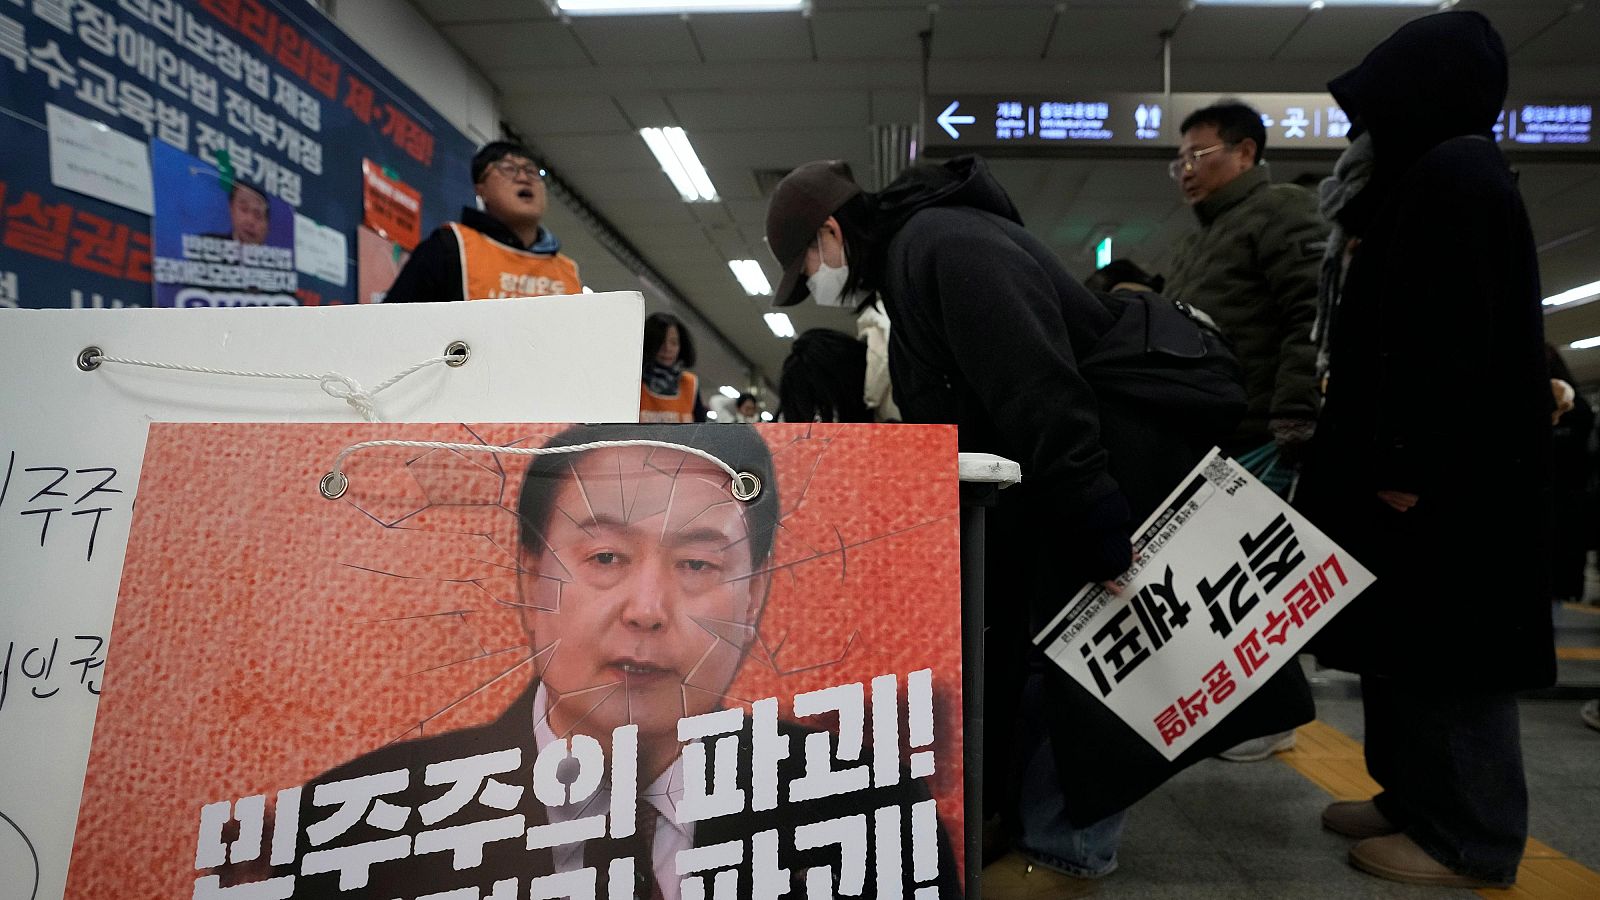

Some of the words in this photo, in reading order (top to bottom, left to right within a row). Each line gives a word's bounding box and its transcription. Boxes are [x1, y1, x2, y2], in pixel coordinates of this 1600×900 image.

[224, 86, 322, 175] 전부개정
[273, 72, 320, 132] 제정
[1280, 107, 1309, 138] 곳
[196, 121, 301, 206] 전부개정
[0, 451, 136, 561] 주주
[1196, 512, 1306, 639] 즉각
[1232, 553, 1349, 679] 내란수괴
[1080, 564, 1191, 698] 체포!
[1153, 660, 1237, 746] 윤석열
[192, 723, 640, 900] 민주주의
[676, 668, 936, 823] 파괴!
